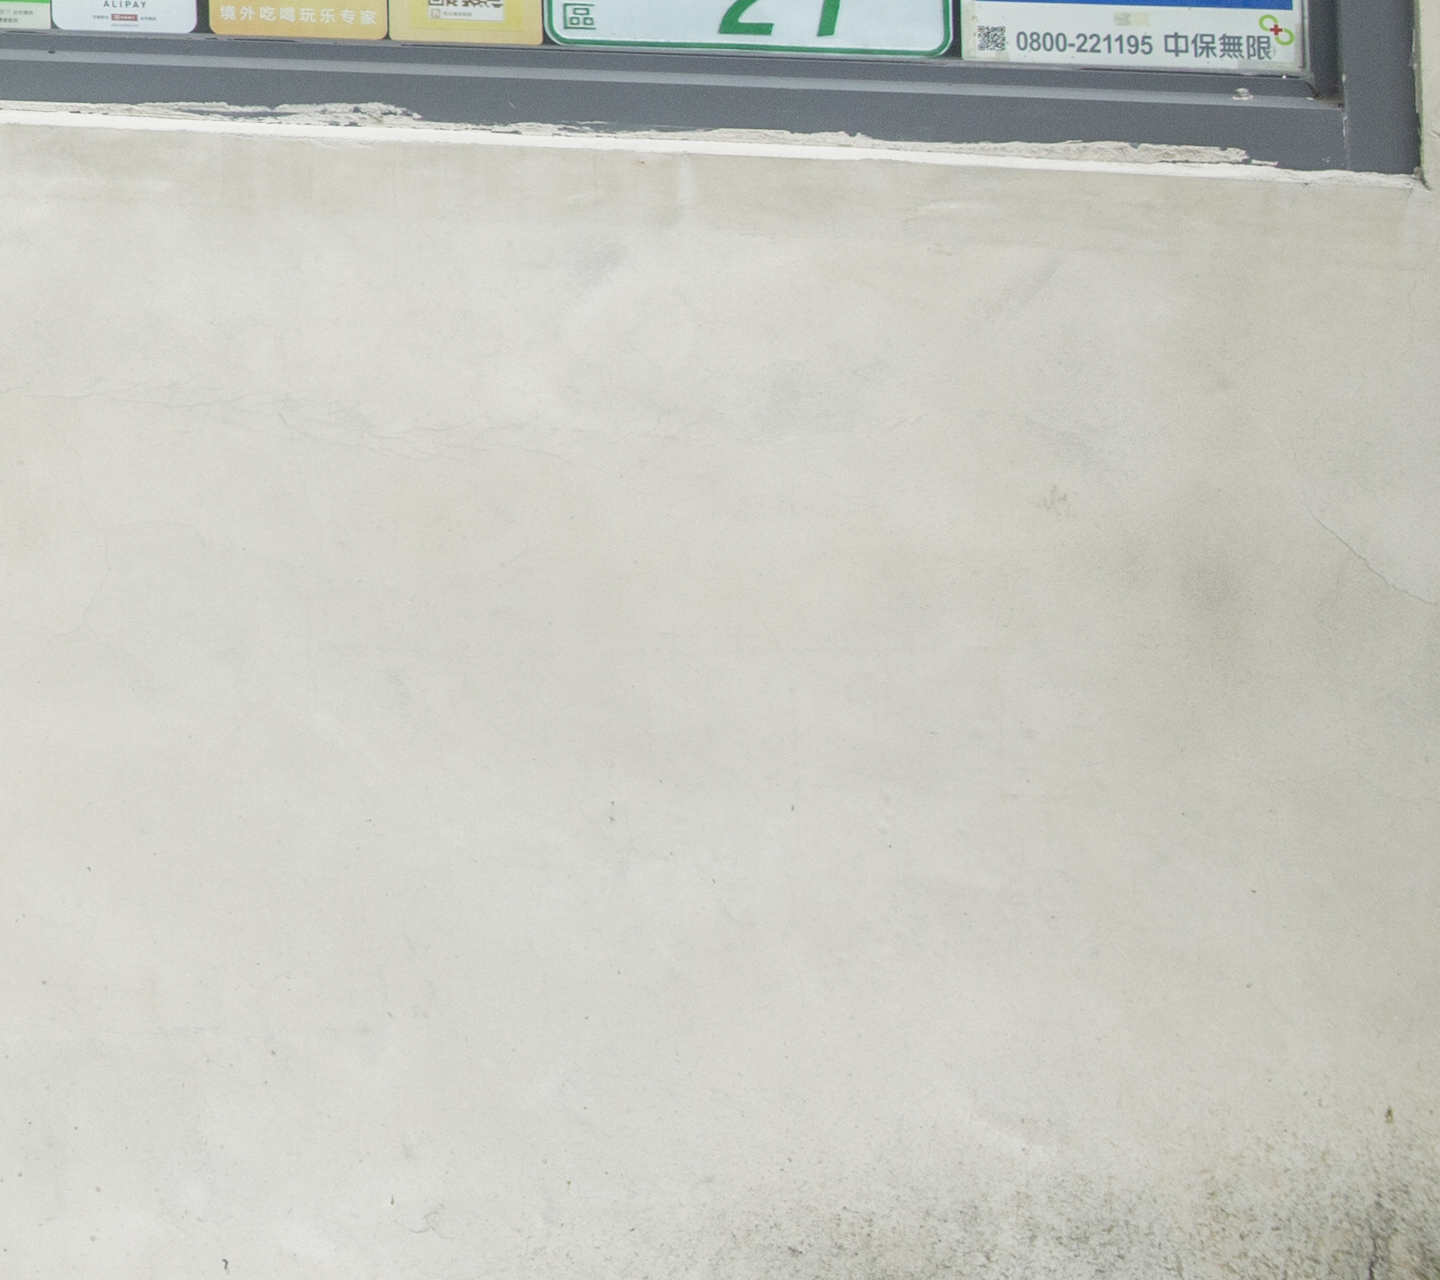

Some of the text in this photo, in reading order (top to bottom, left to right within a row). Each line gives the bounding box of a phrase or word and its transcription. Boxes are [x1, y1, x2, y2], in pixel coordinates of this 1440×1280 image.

[103, 0, 147, 9] ALIPAY
[219, 4, 378, 26] 境外吃喝玩乐专家
[1015, 30, 1273, 60] 0800-221195 中保無限
